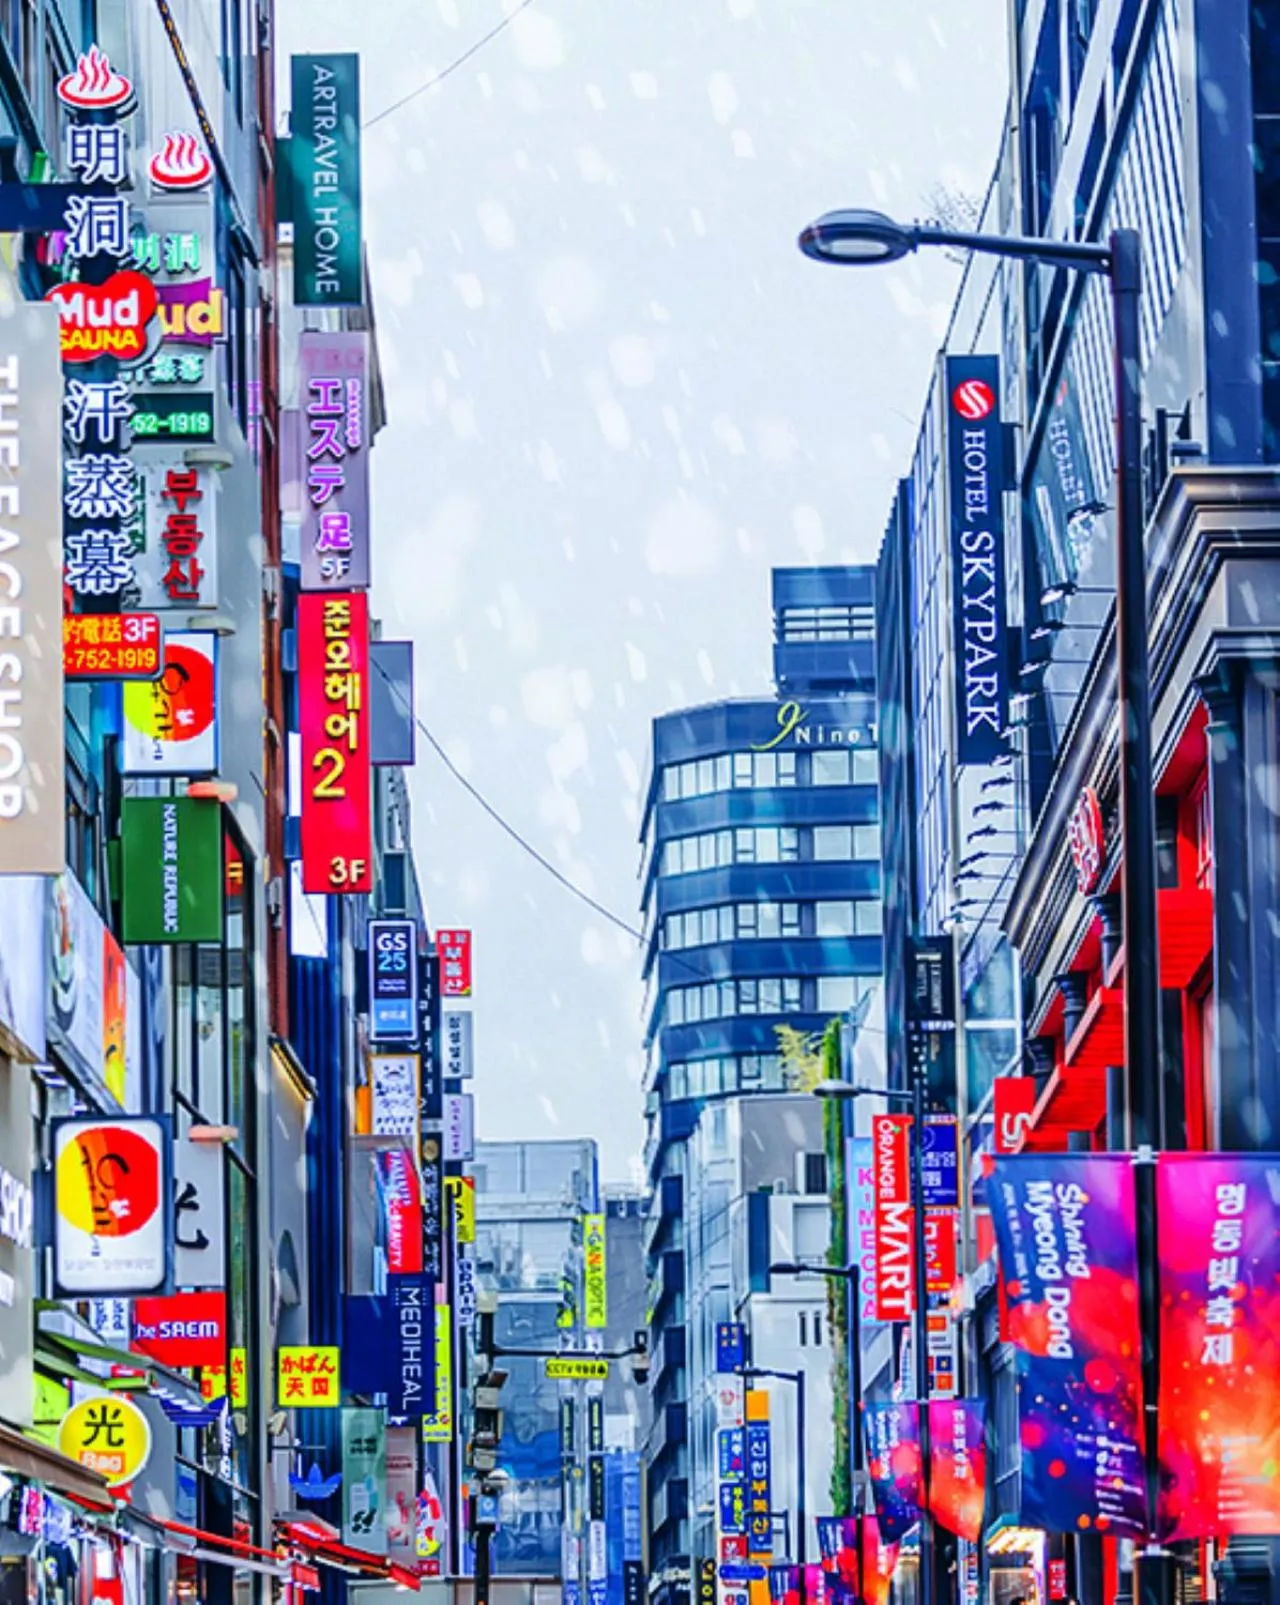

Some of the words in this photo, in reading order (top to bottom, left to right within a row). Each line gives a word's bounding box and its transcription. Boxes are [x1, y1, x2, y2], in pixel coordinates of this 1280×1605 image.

[311, 65, 339, 198] ARTRAVEL
[64, 125, 130, 258] 明洞
[313, 207, 341, 294] HOME
[52, 289, 139, 328] Mud
[157, 289, 224, 335] ud
[60, 329, 139, 351] SAUNA
[63, 380, 134, 595] 汗蒸幕
[962, 429, 986, 523] HOTEL
[161, 469, 204, 600] 부동산
[321, 557, 351, 577] 5F
[124, 616, 156, 643] 3F
[960, 531, 1001, 738] SKYPARK
[0, 653, 23, 818] SHOP
[312, 747, 346, 798] 2
[329, 856, 366, 884] 3F
[376, 932, 408, 952] GS
[376, 952, 408, 972] 25
[877, 1118, 897, 1199] ORANGE
[1055, 1183, 1091, 1279] Shining
[880, 1202, 911, 1316] MART
[1024, 1180, 1064, 1281] Myeong
[1044, 1286, 1074, 1359] Dong
[136, 1323, 156, 1339] he
[159, 1320, 220, 1339] SAEM
[281, 1353, 336, 1375] かばん
[82, 1405, 125, 1447] 光
[83, 1451, 122, 1472] Bag
